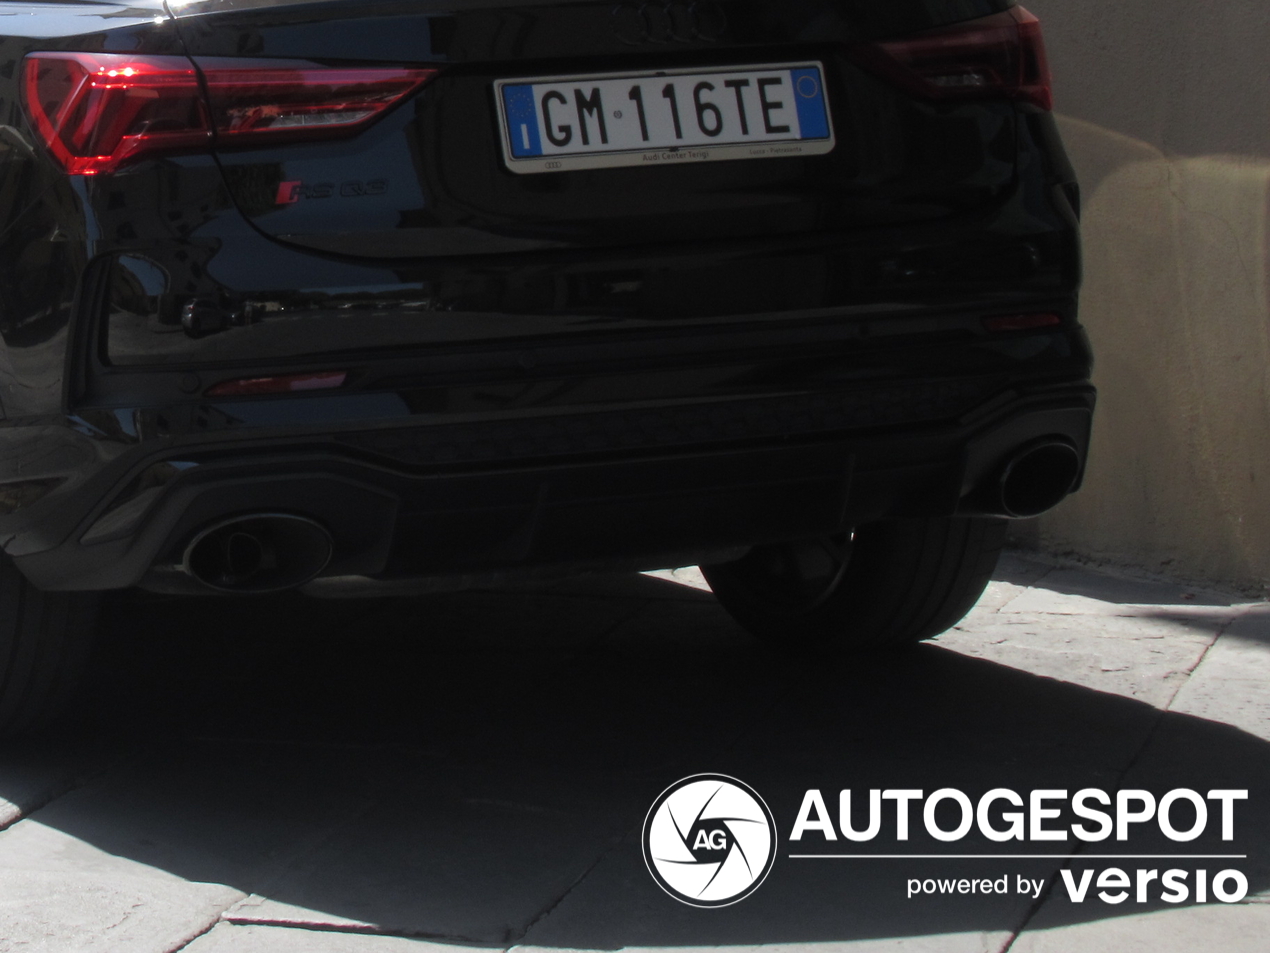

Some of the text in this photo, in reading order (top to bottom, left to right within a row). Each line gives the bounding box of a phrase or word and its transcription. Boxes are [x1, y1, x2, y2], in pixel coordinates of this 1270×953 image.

[642, 149, 709, 162] Audi Center Terigi
[288, 178, 390, 200] RS Q3
